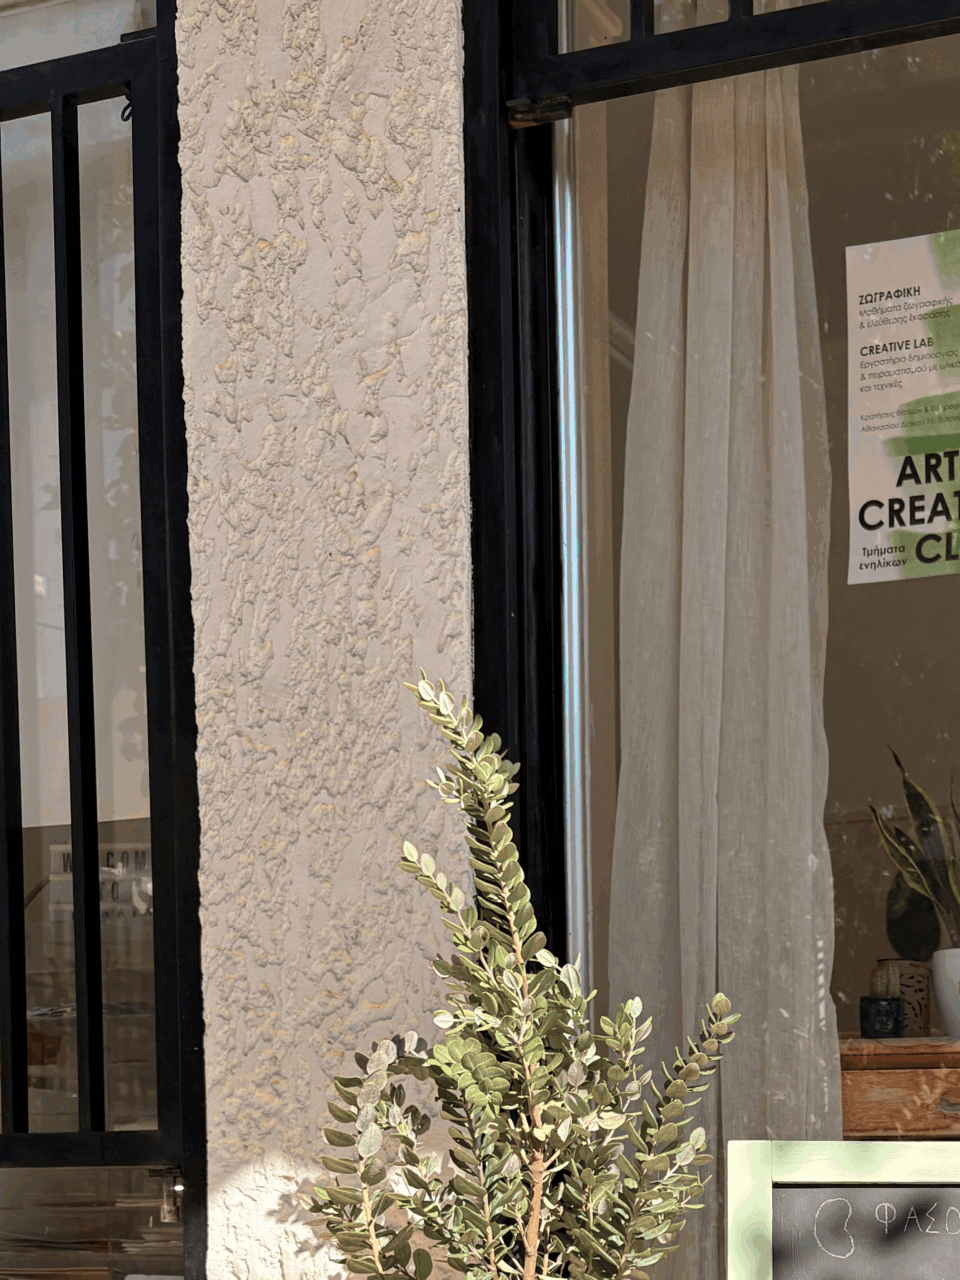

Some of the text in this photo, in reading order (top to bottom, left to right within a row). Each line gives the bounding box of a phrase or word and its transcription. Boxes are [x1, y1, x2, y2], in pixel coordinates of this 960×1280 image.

[858, 286, 921, 305] ΖΩΓΡΑΦΙΚΗ
[859, 305, 902, 317] Μαθήματα
[860, 337, 934, 356] CREATIVE LAB
[860, 356, 907, 369] Εργαστήριο
[896, 450, 960, 488] ART
[862, 544, 906, 558] Τμήματα
[859, 557, 908, 571] ενηλίκων
